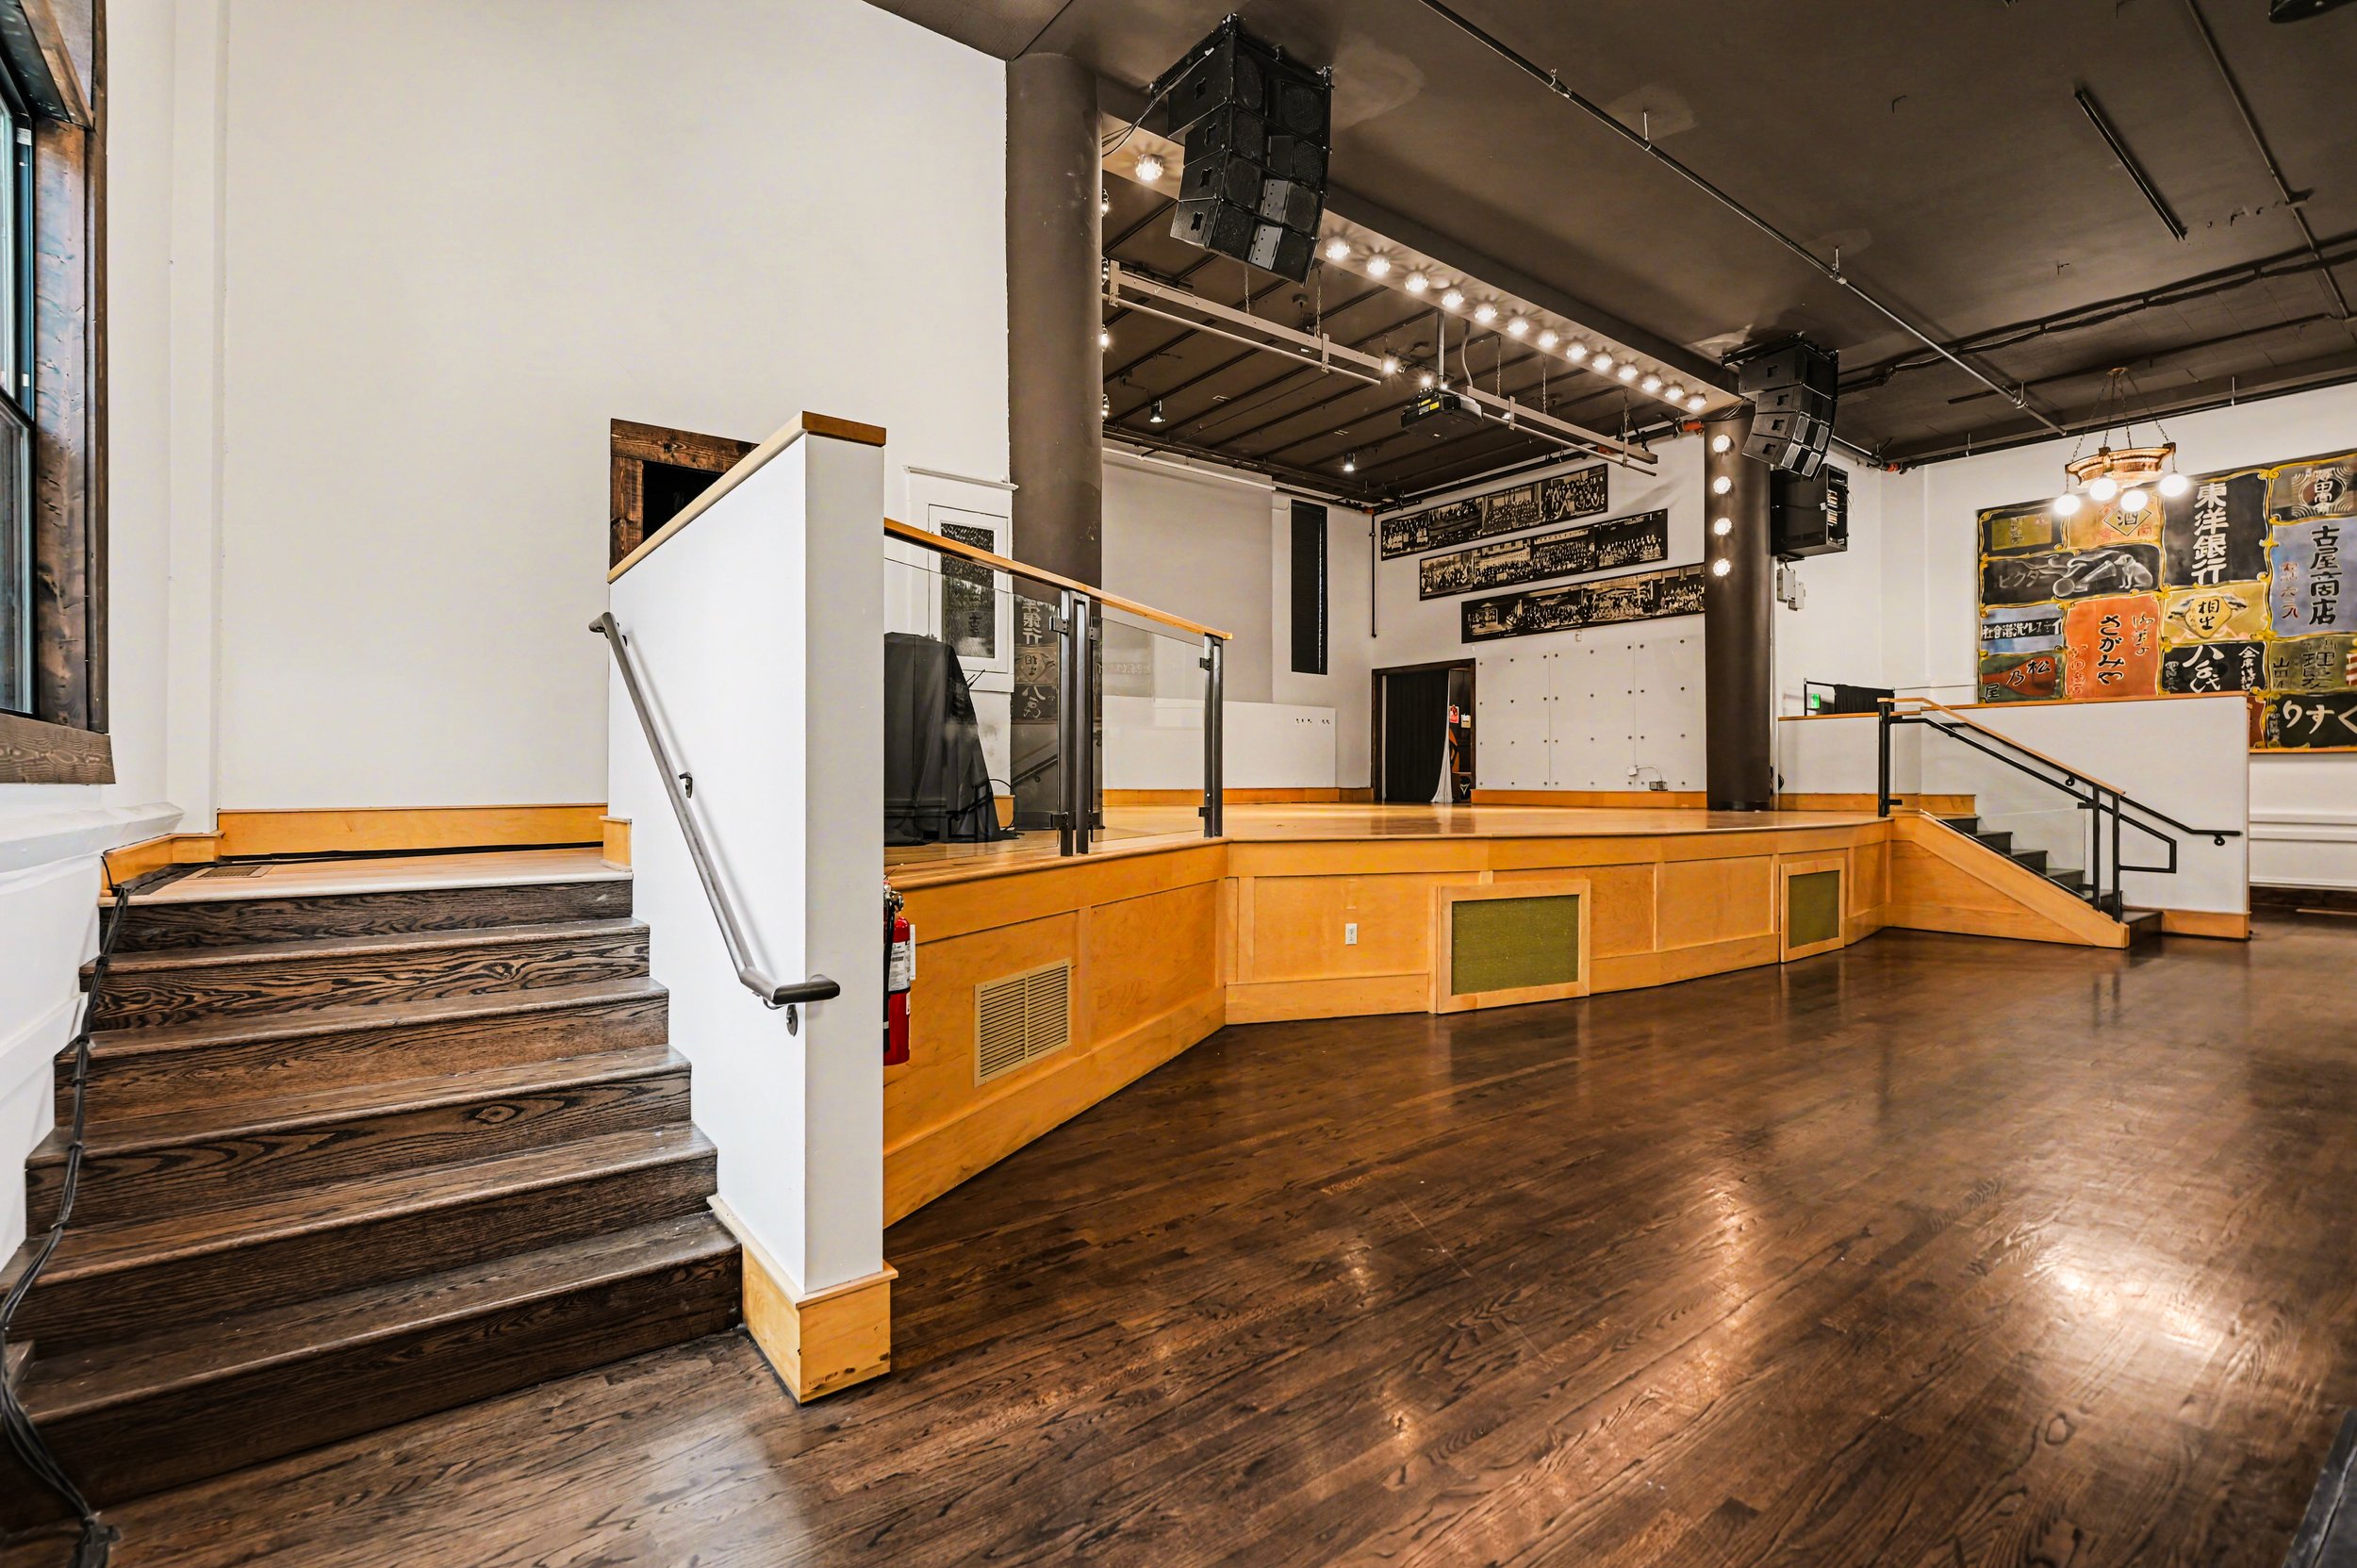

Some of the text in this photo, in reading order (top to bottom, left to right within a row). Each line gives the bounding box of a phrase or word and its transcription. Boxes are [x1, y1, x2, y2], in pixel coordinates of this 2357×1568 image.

[2191, 483, 2229, 585] 東洋銀行
[2309, 525, 2343, 626] 古屋商店
[2098, 615, 2125, 685] さがみや
